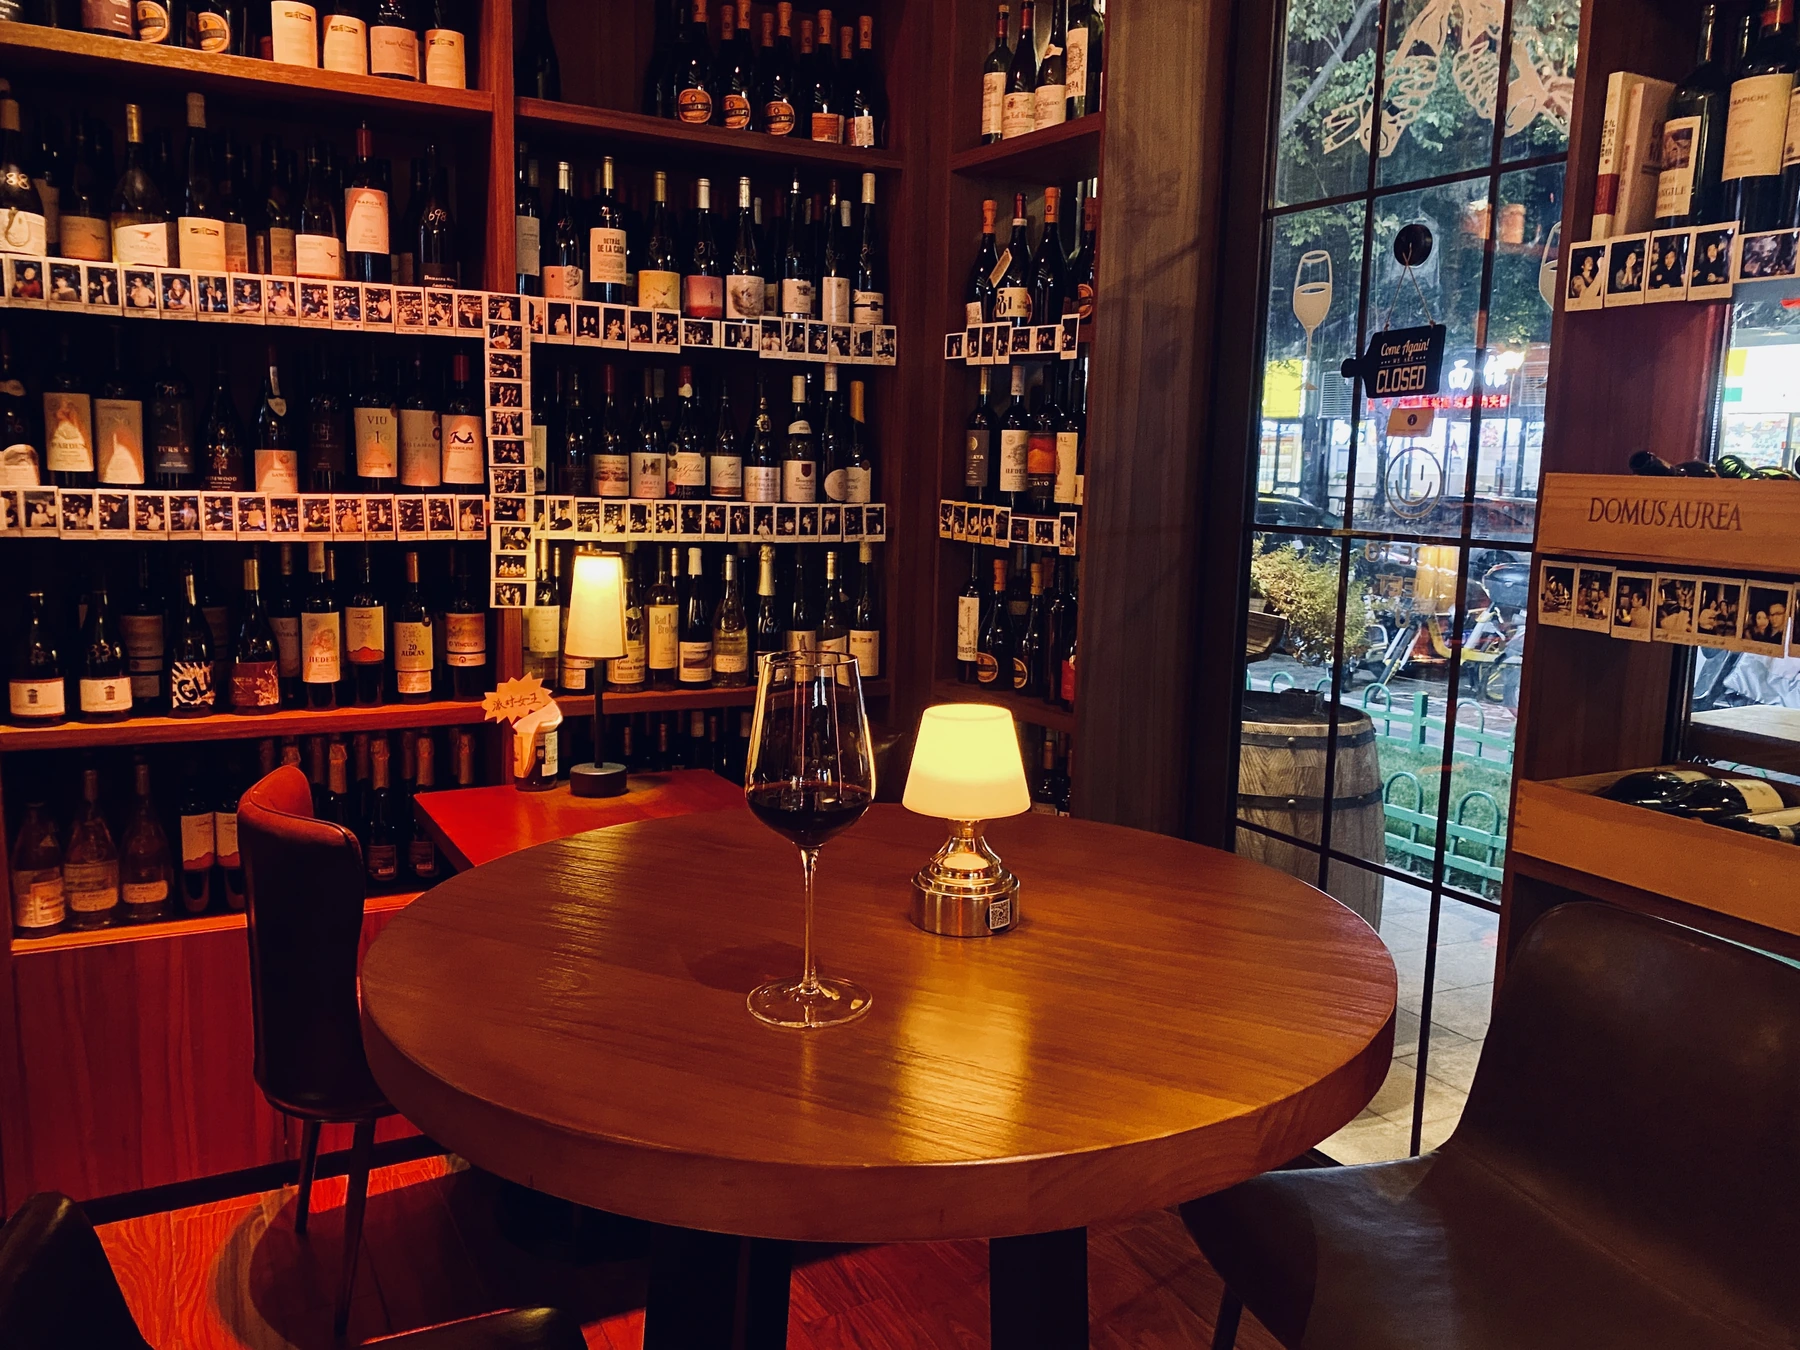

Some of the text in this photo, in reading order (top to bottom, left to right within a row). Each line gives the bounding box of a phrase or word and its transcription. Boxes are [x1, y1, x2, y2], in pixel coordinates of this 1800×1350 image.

[1381, 337, 1431, 356] Come Again!
[1376, 365, 1427, 394] CLOSED
[367, 415, 388, 425] VIU
[1587, 497, 1744, 531] DOMUS AUREA
[407, 643, 418, 651] 20
